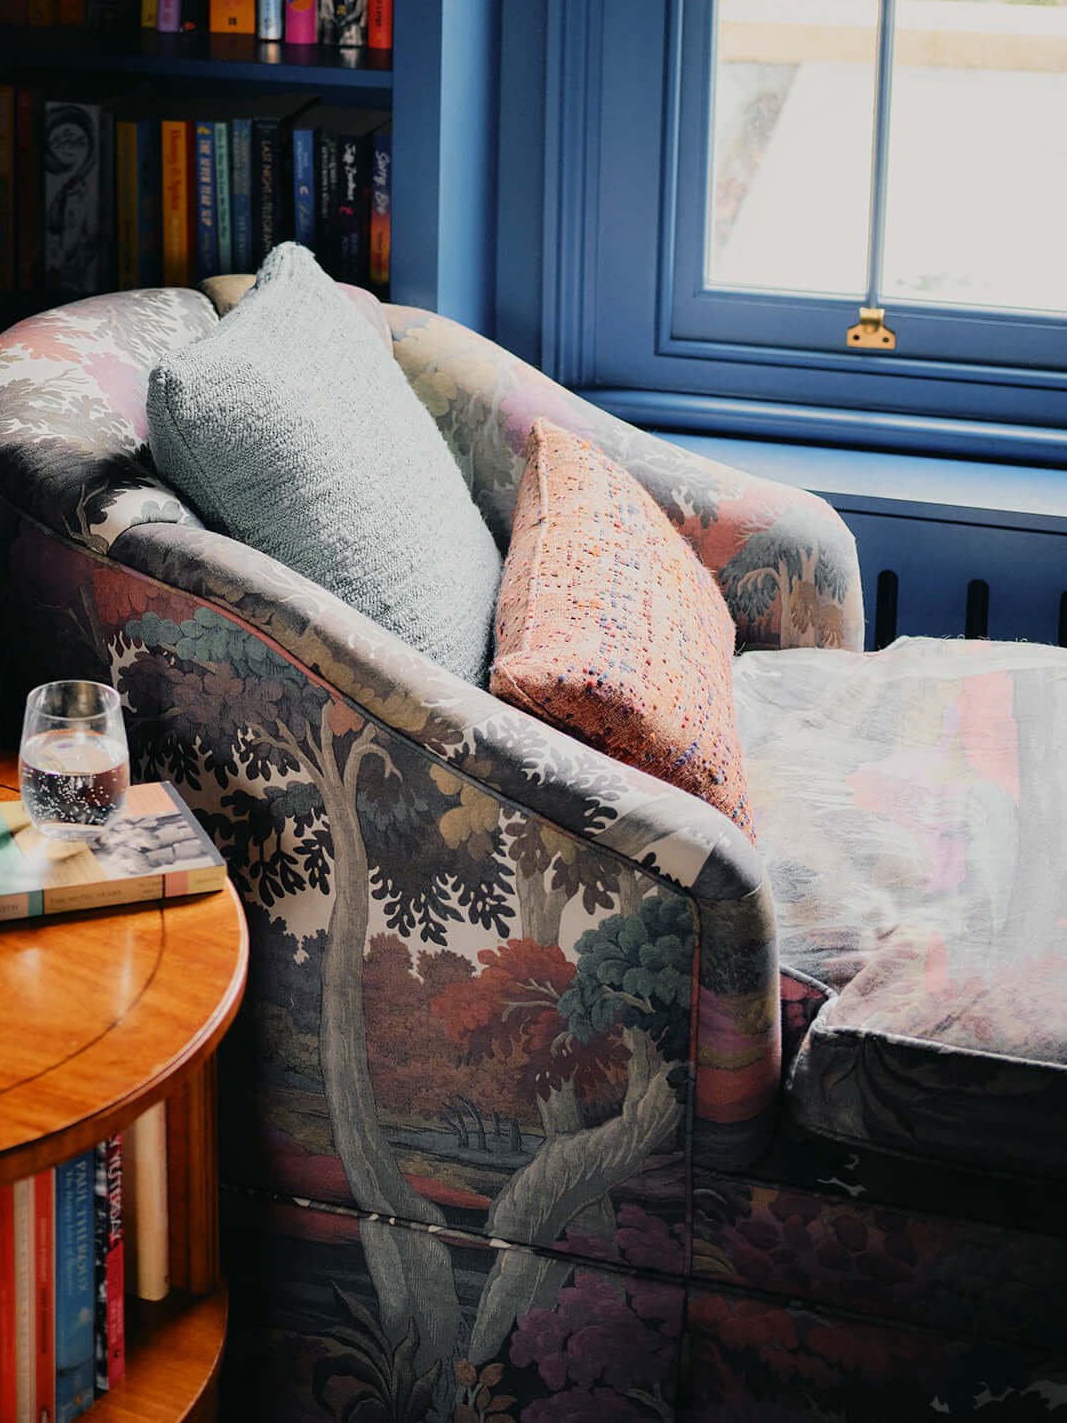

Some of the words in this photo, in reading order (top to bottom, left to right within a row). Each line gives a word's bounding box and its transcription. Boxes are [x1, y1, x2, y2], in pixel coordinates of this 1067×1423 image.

[200, 139, 212, 155] THE
[261, 140, 274, 163] LAST
[200, 158, 213, 183] SEVEN
[261, 164, 274, 193] NIGHT
[75, 1160, 88, 1202] PAUL
[76, 1208, 89, 1292] THEROUX
